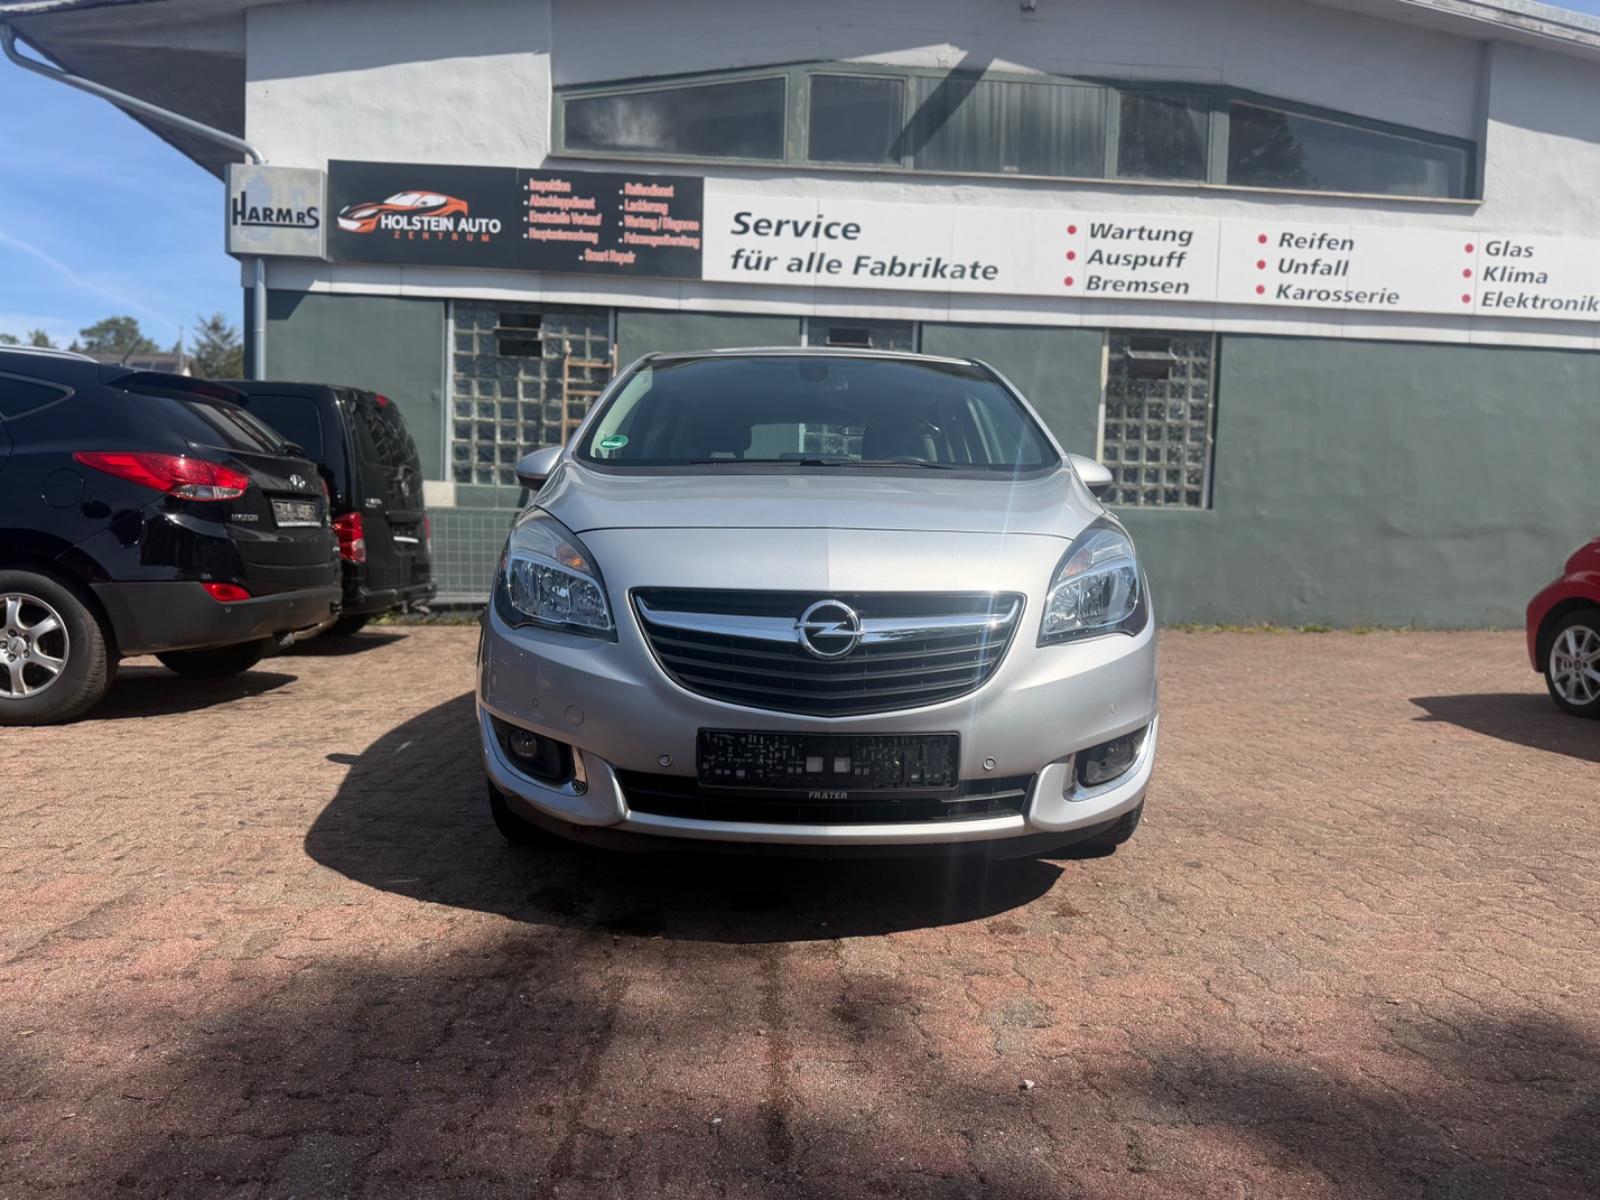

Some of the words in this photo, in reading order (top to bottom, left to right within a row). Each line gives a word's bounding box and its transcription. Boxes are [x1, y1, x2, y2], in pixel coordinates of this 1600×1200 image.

[381, 214, 454, 232] HOLSTEIN
[457, 219, 502, 234] AUTO
[731, 211, 861, 240] Service
[1089, 222, 1194, 247] Wartung
[1278, 232, 1355, 251] Reifen
[1485, 240, 1534, 258] Glas
[731, 248, 777, 272] für
[786, 252, 843, 275] alle
[852, 255, 999, 281] Fabrikate
[1086, 249, 1187, 271] Auspuff
[1277, 257, 1350, 277] Unfall
[1086, 275, 1190, 295] Bremsen
[1482, 265, 1548, 285] Klima
[1275, 283, 1400, 305] Karosserie
[1481, 291, 1600, 313] Elektronik
[808, 790, 848, 800] FRATER
